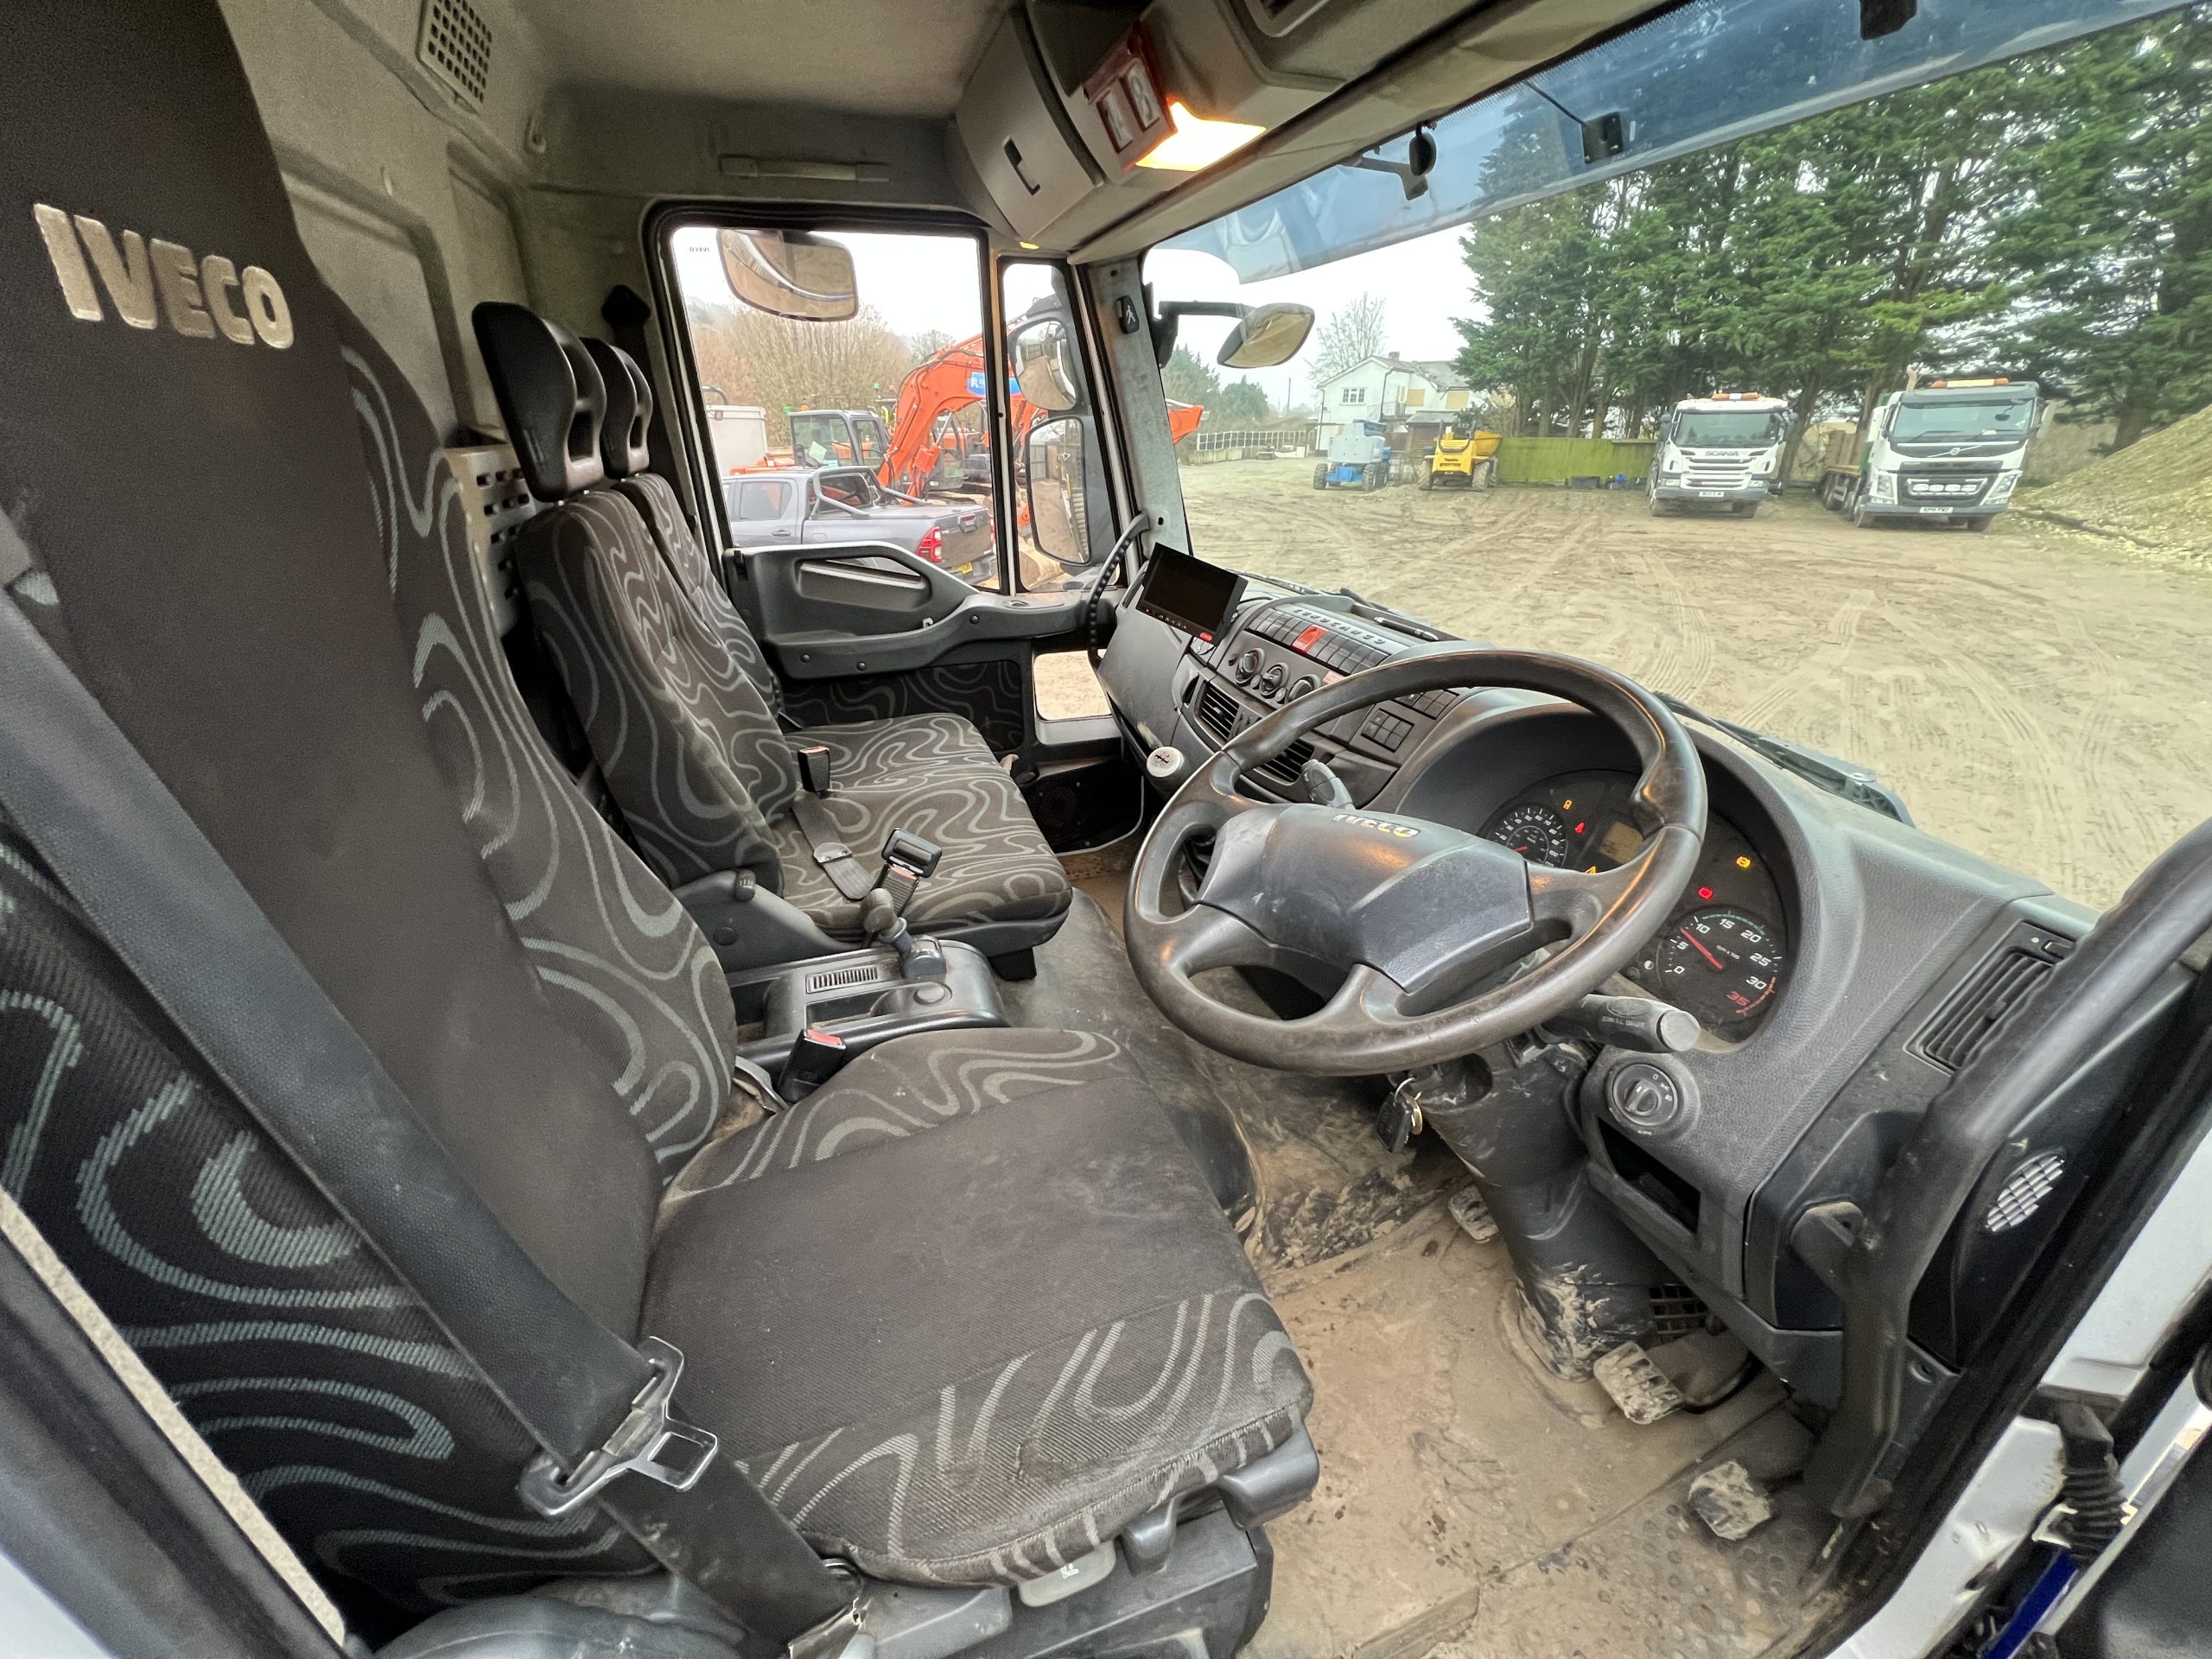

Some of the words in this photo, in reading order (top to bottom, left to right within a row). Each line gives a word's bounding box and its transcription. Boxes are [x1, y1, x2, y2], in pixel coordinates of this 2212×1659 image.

[33, 202, 295, 349] IVECO
[1332, 813, 1421, 838] IVECO
[1695, 923, 1711, 934] 10
[1719, 918, 1735, 930] 15
[1740, 929, 1762, 944] 20
[1676, 941, 1688, 950] 5
[1749, 952, 1771, 967] 25
[1674, 965, 1685, 975] 0
[1745, 976, 1767, 990] 30
[1726, 990, 1750, 1007] 35
